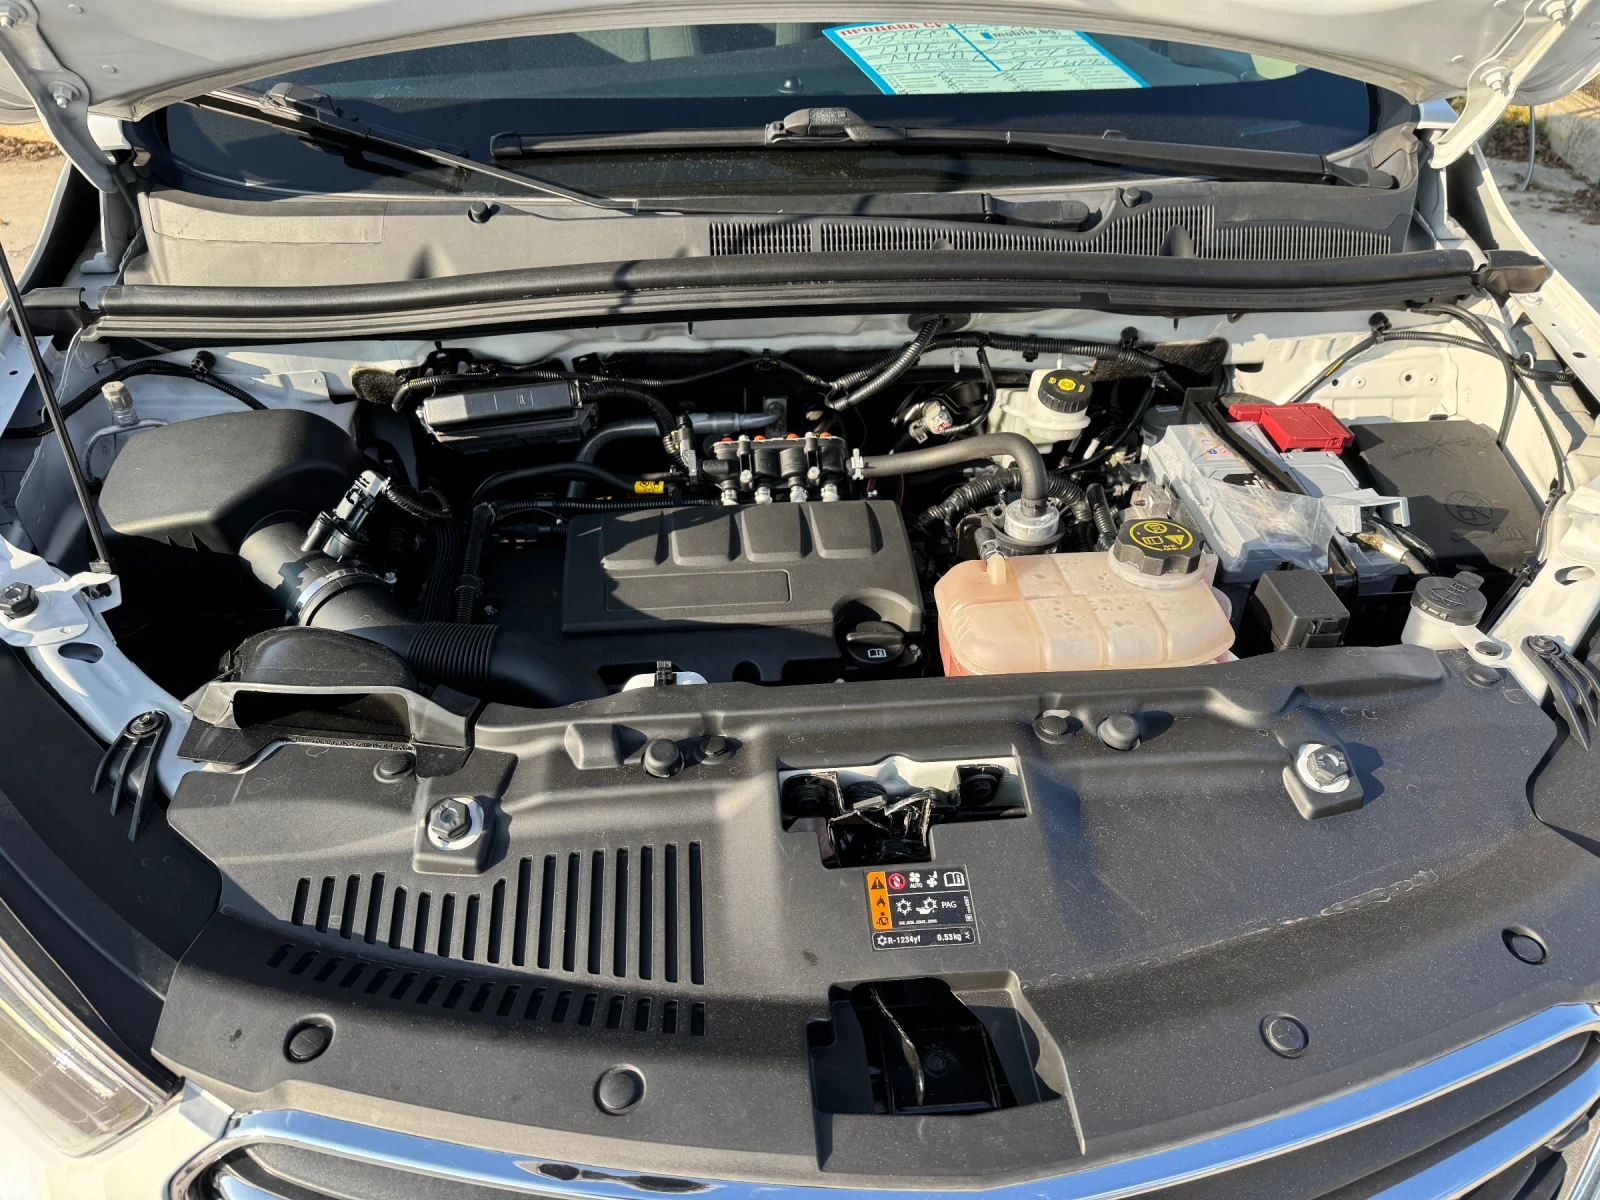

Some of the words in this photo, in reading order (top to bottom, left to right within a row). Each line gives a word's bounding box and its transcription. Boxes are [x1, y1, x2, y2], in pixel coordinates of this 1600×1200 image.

[840, 23, 920, 36] ПРОДАВА
[992, 28, 1058, 39] mobile.bg
[941, 900, 957, 908] PAG
[887, 935, 921, 944] R-1234yf
